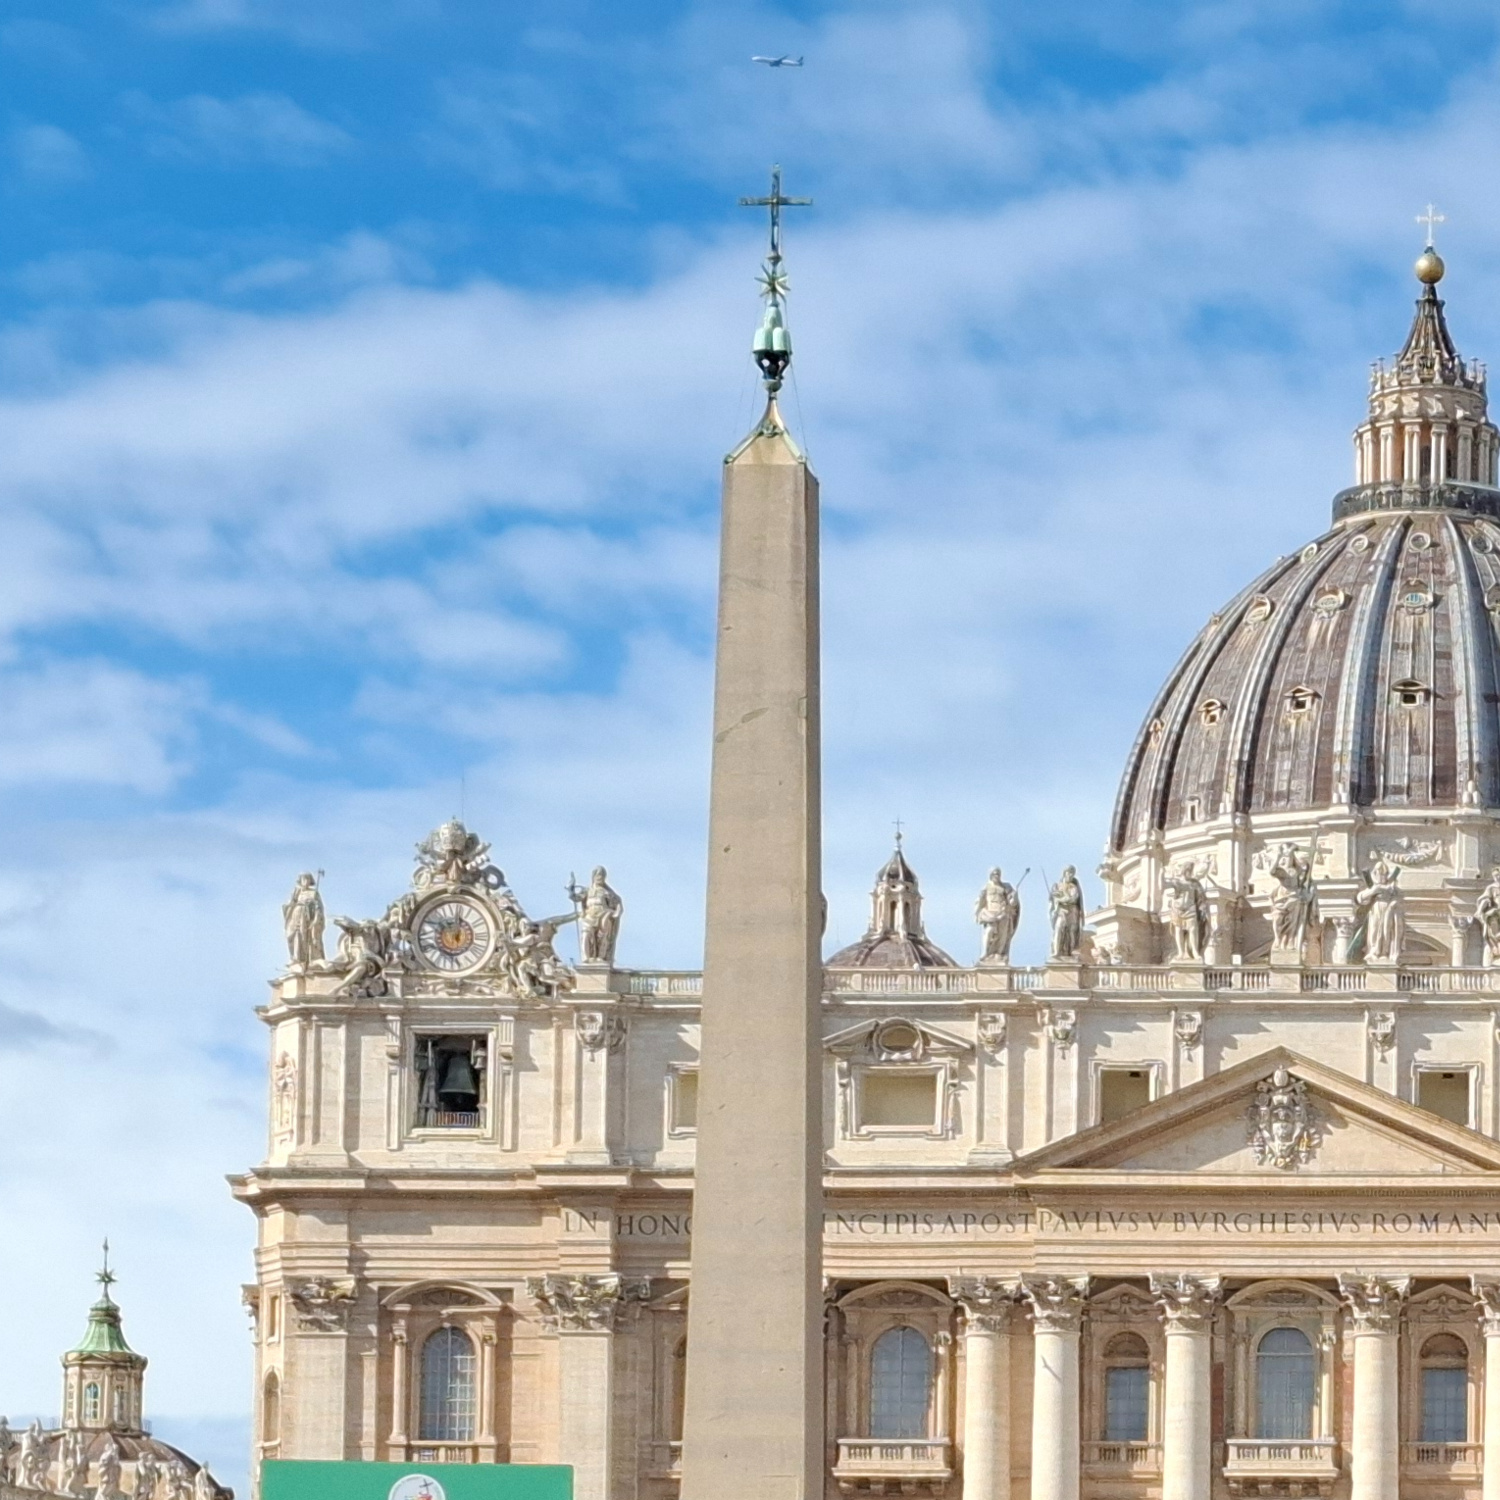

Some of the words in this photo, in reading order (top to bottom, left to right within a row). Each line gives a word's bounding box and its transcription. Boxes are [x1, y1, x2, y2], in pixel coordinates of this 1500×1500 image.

[564, 1210, 597, 1233] IN
[941, 1213, 1035, 1234] APOST
[1038, 1211, 1140, 1233] PAVLVS
[1173, 1212, 1362, 1233] BVRGHESIVS
